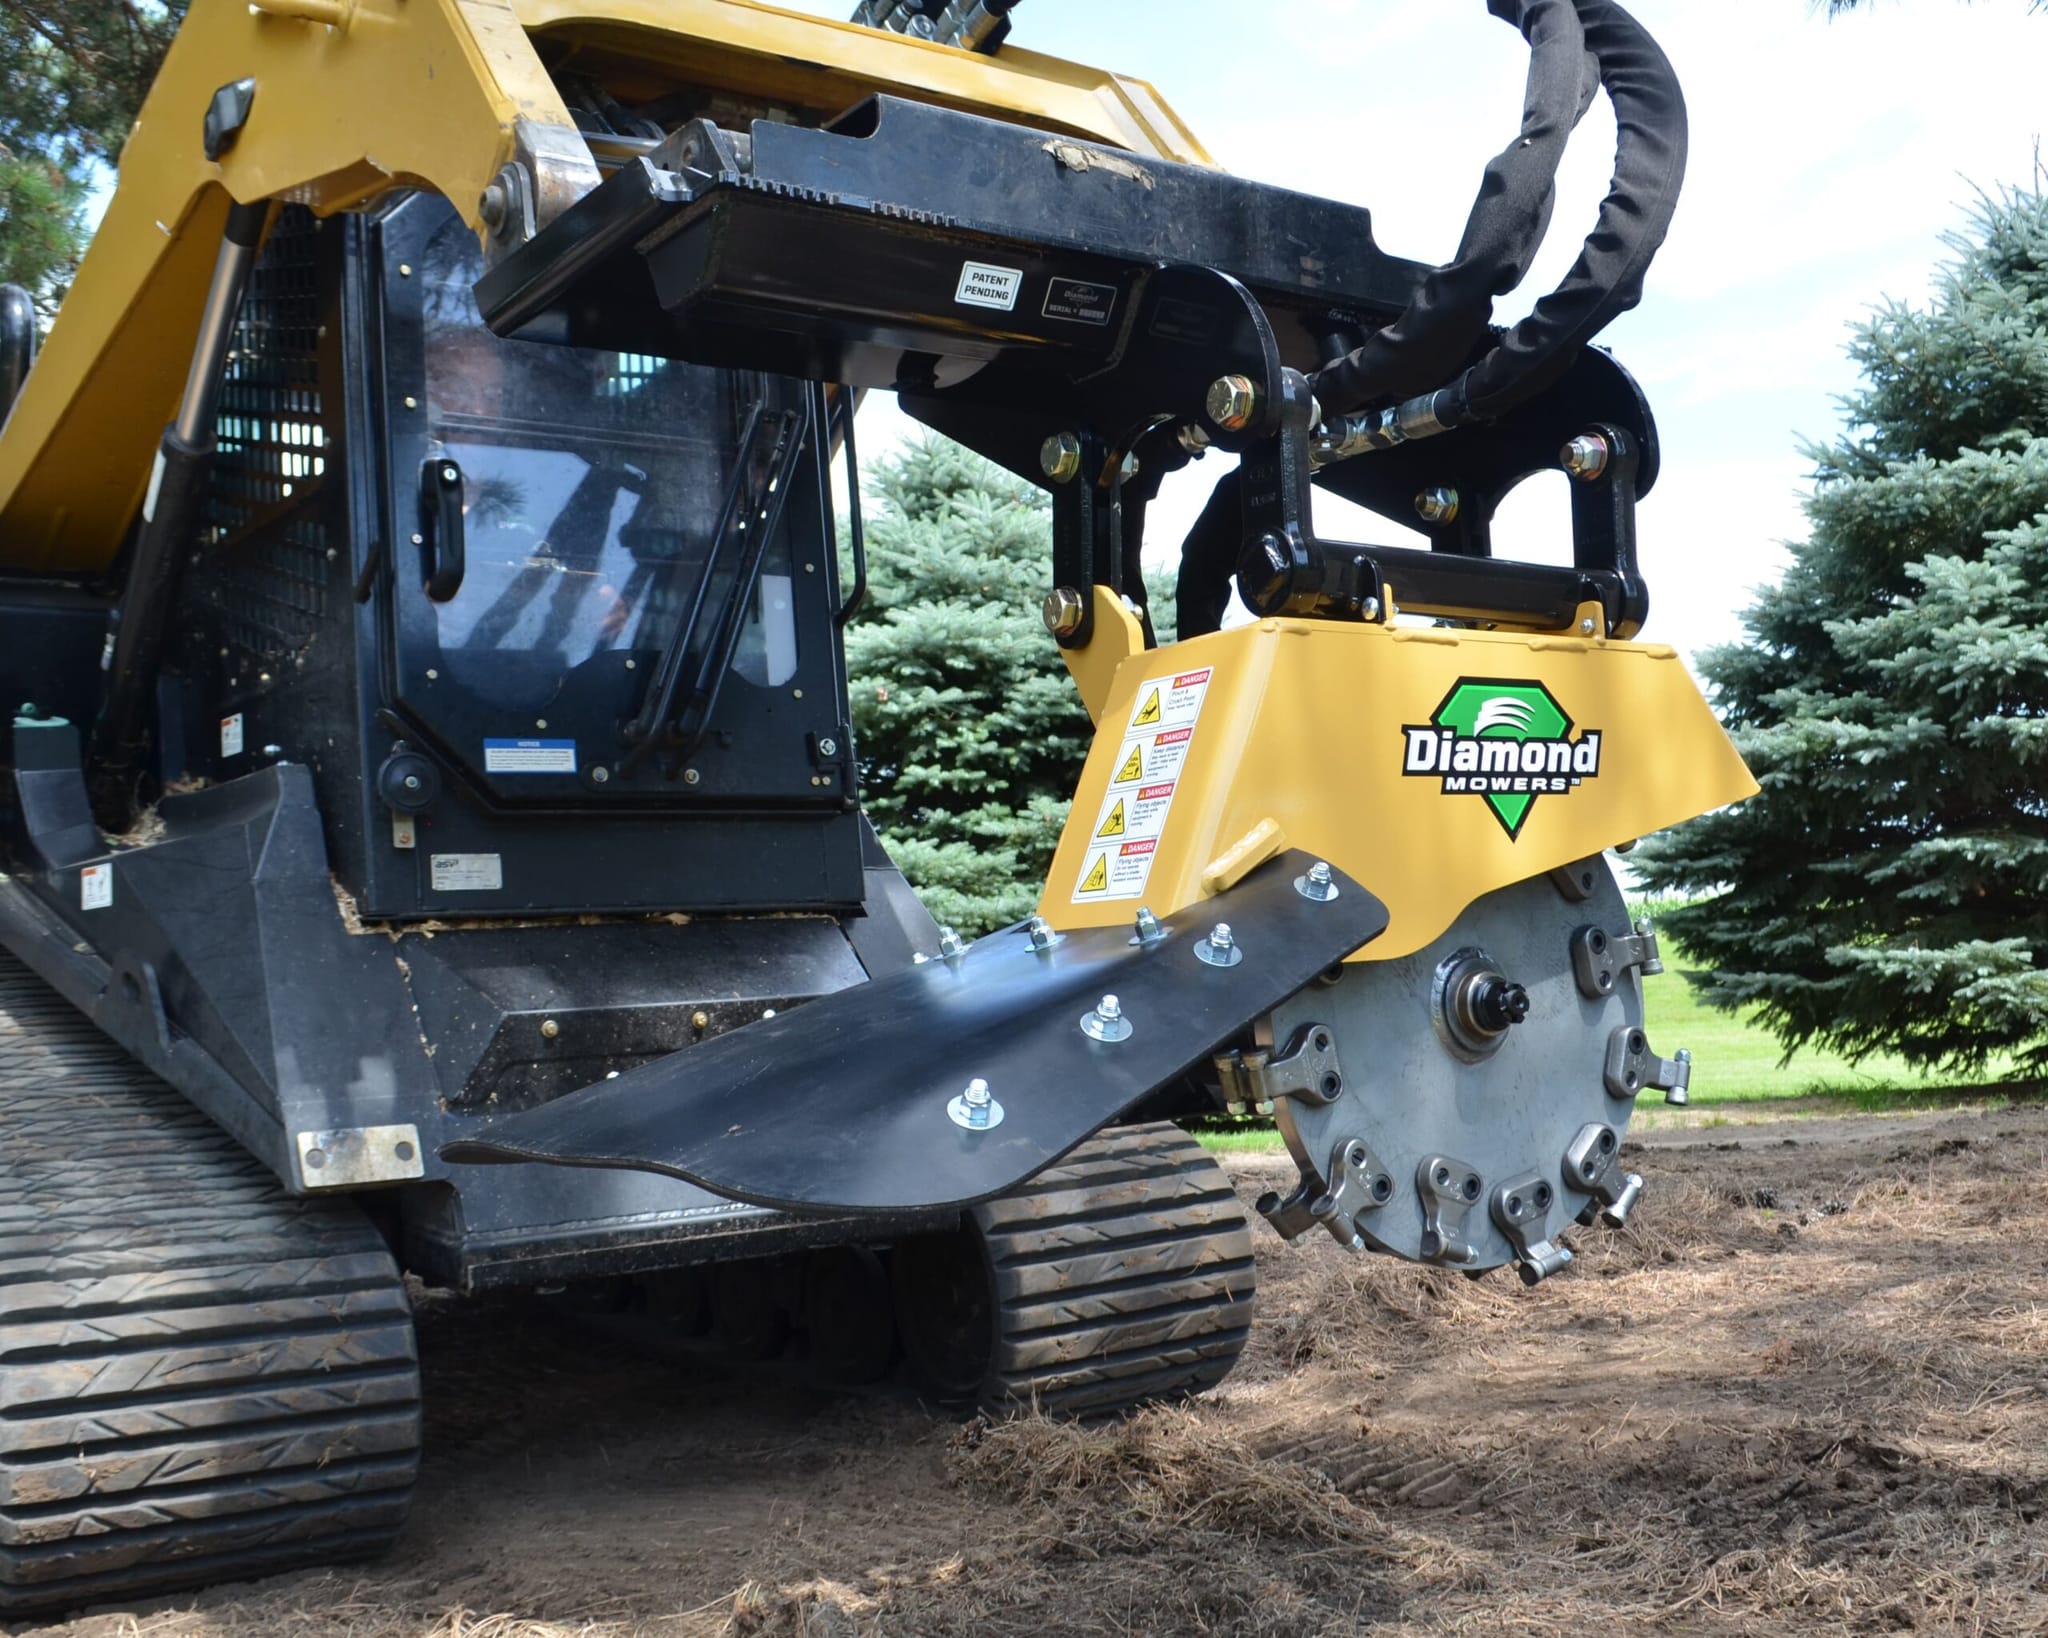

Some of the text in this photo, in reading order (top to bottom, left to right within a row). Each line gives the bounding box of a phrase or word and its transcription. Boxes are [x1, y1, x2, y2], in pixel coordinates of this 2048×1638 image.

[971, 271, 1010, 287] PATENT
[964, 285, 1010, 301] PENDING
[1181, 671, 1208, 686] DANGER
[1163, 729, 1190, 743] DANGER
[1405, 729, 1600, 773] Diamond
[1145, 784, 1173, 798] DANGER
[1445, 776, 1567, 791] MOWERS
[1128, 841, 1155, 854] DANGER
